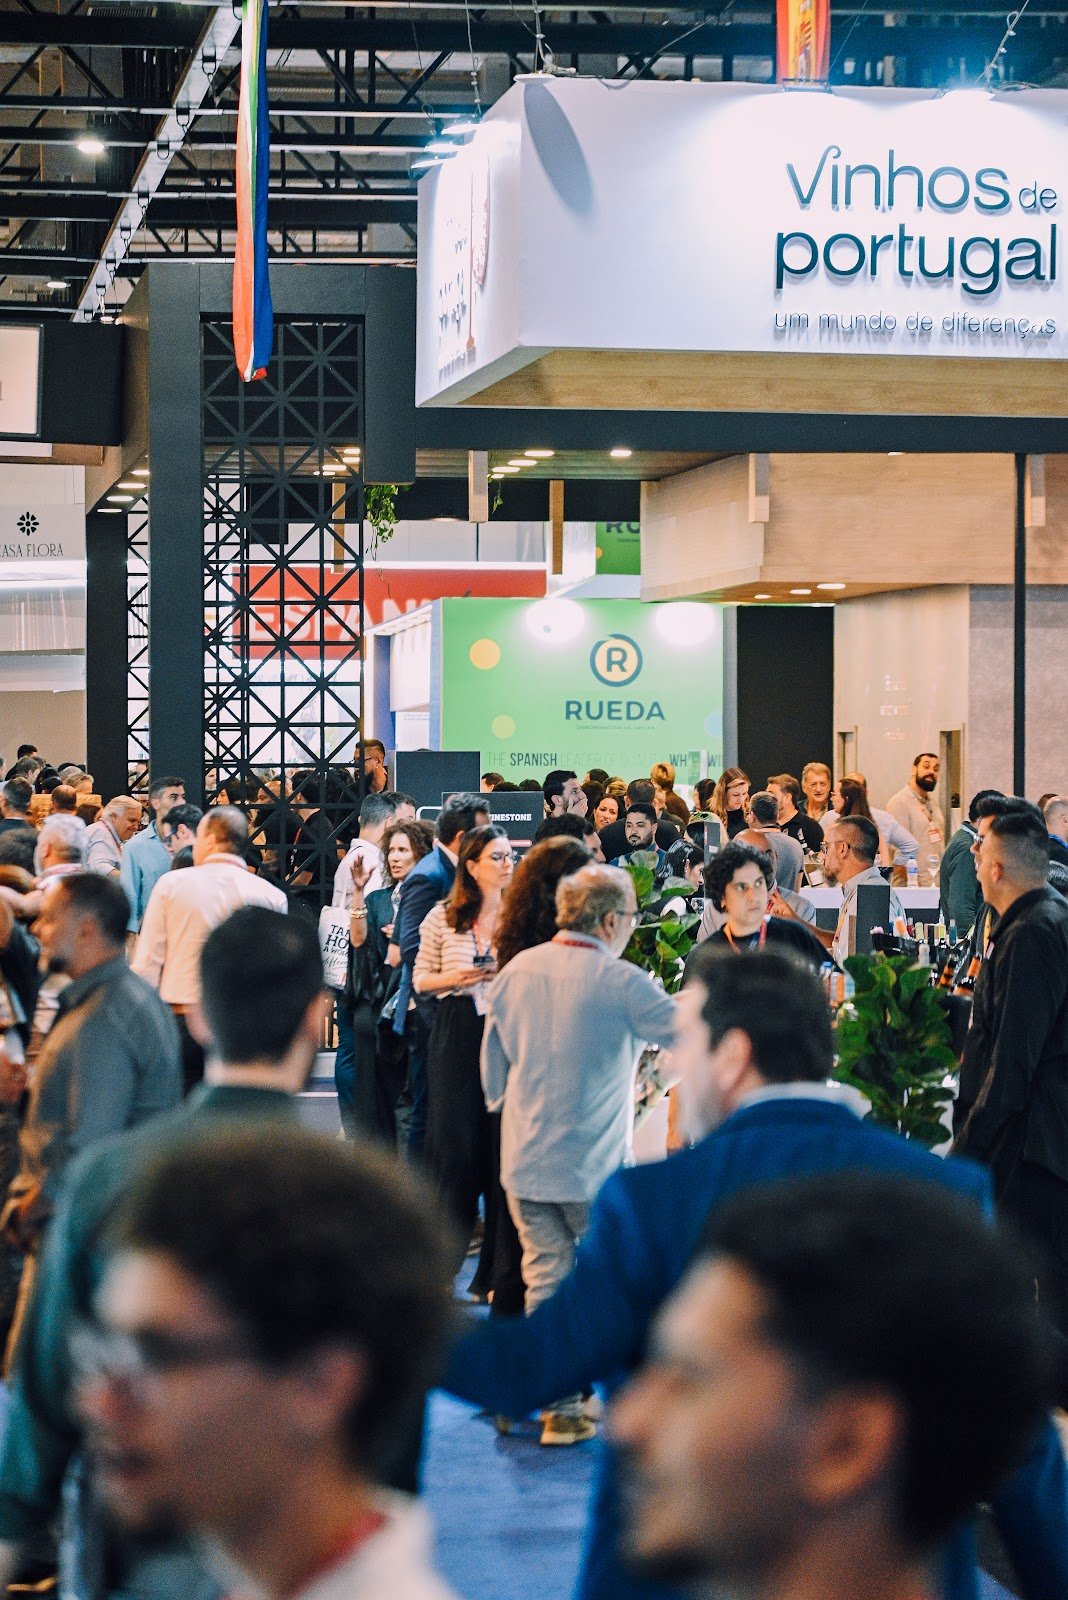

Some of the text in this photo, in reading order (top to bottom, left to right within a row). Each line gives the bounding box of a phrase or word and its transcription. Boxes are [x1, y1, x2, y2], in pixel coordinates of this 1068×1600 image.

[1018, 180, 1058, 209] de
[776, 223, 1057, 295] portugal
[775, 311, 1057, 338] um mundo de diferenças
[0, 543, 64, 557] ASA FLORA
[606, 647, 627, 672] R
[565, 700, 666, 721] RUEDA
[509, 752, 557, 767] SPANISH
[489, 813, 532, 822] INESTONE
